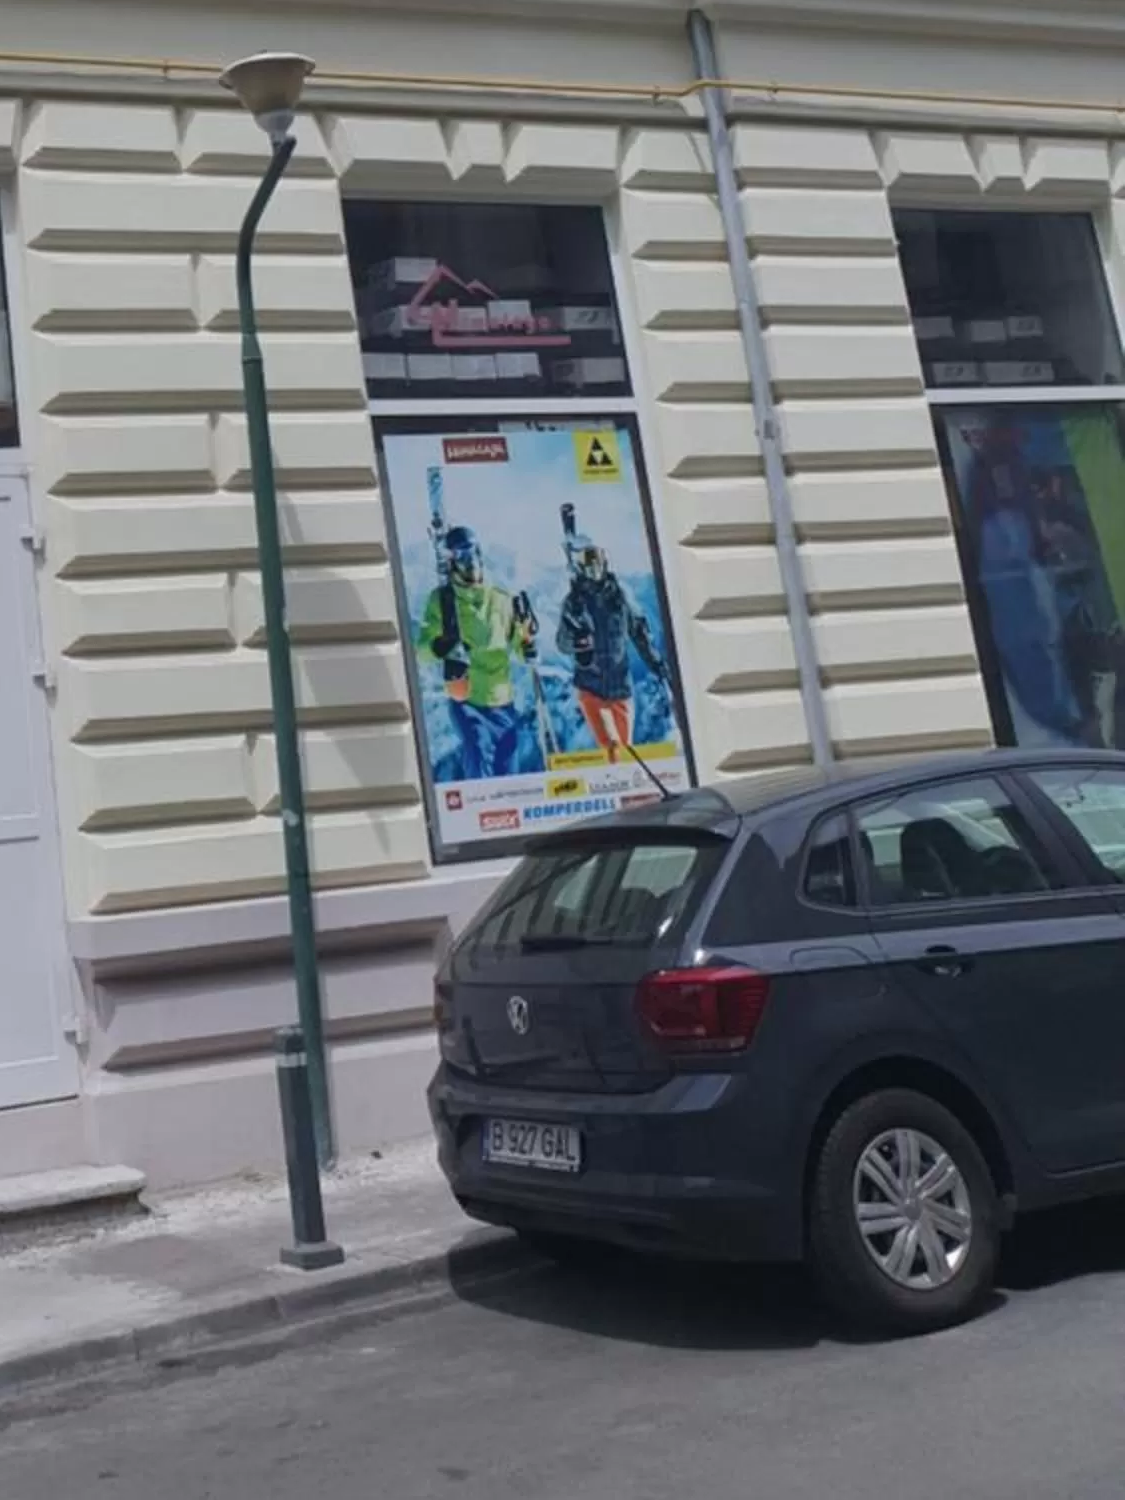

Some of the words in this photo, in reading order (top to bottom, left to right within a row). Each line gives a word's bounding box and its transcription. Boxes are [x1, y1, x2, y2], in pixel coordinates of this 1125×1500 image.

[523, 798, 616, 820] KOMPERDELL
[492, 1121, 504, 1151] B
[508, 1123, 537, 1155] 927
[541, 1126, 576, 1161] GAL
